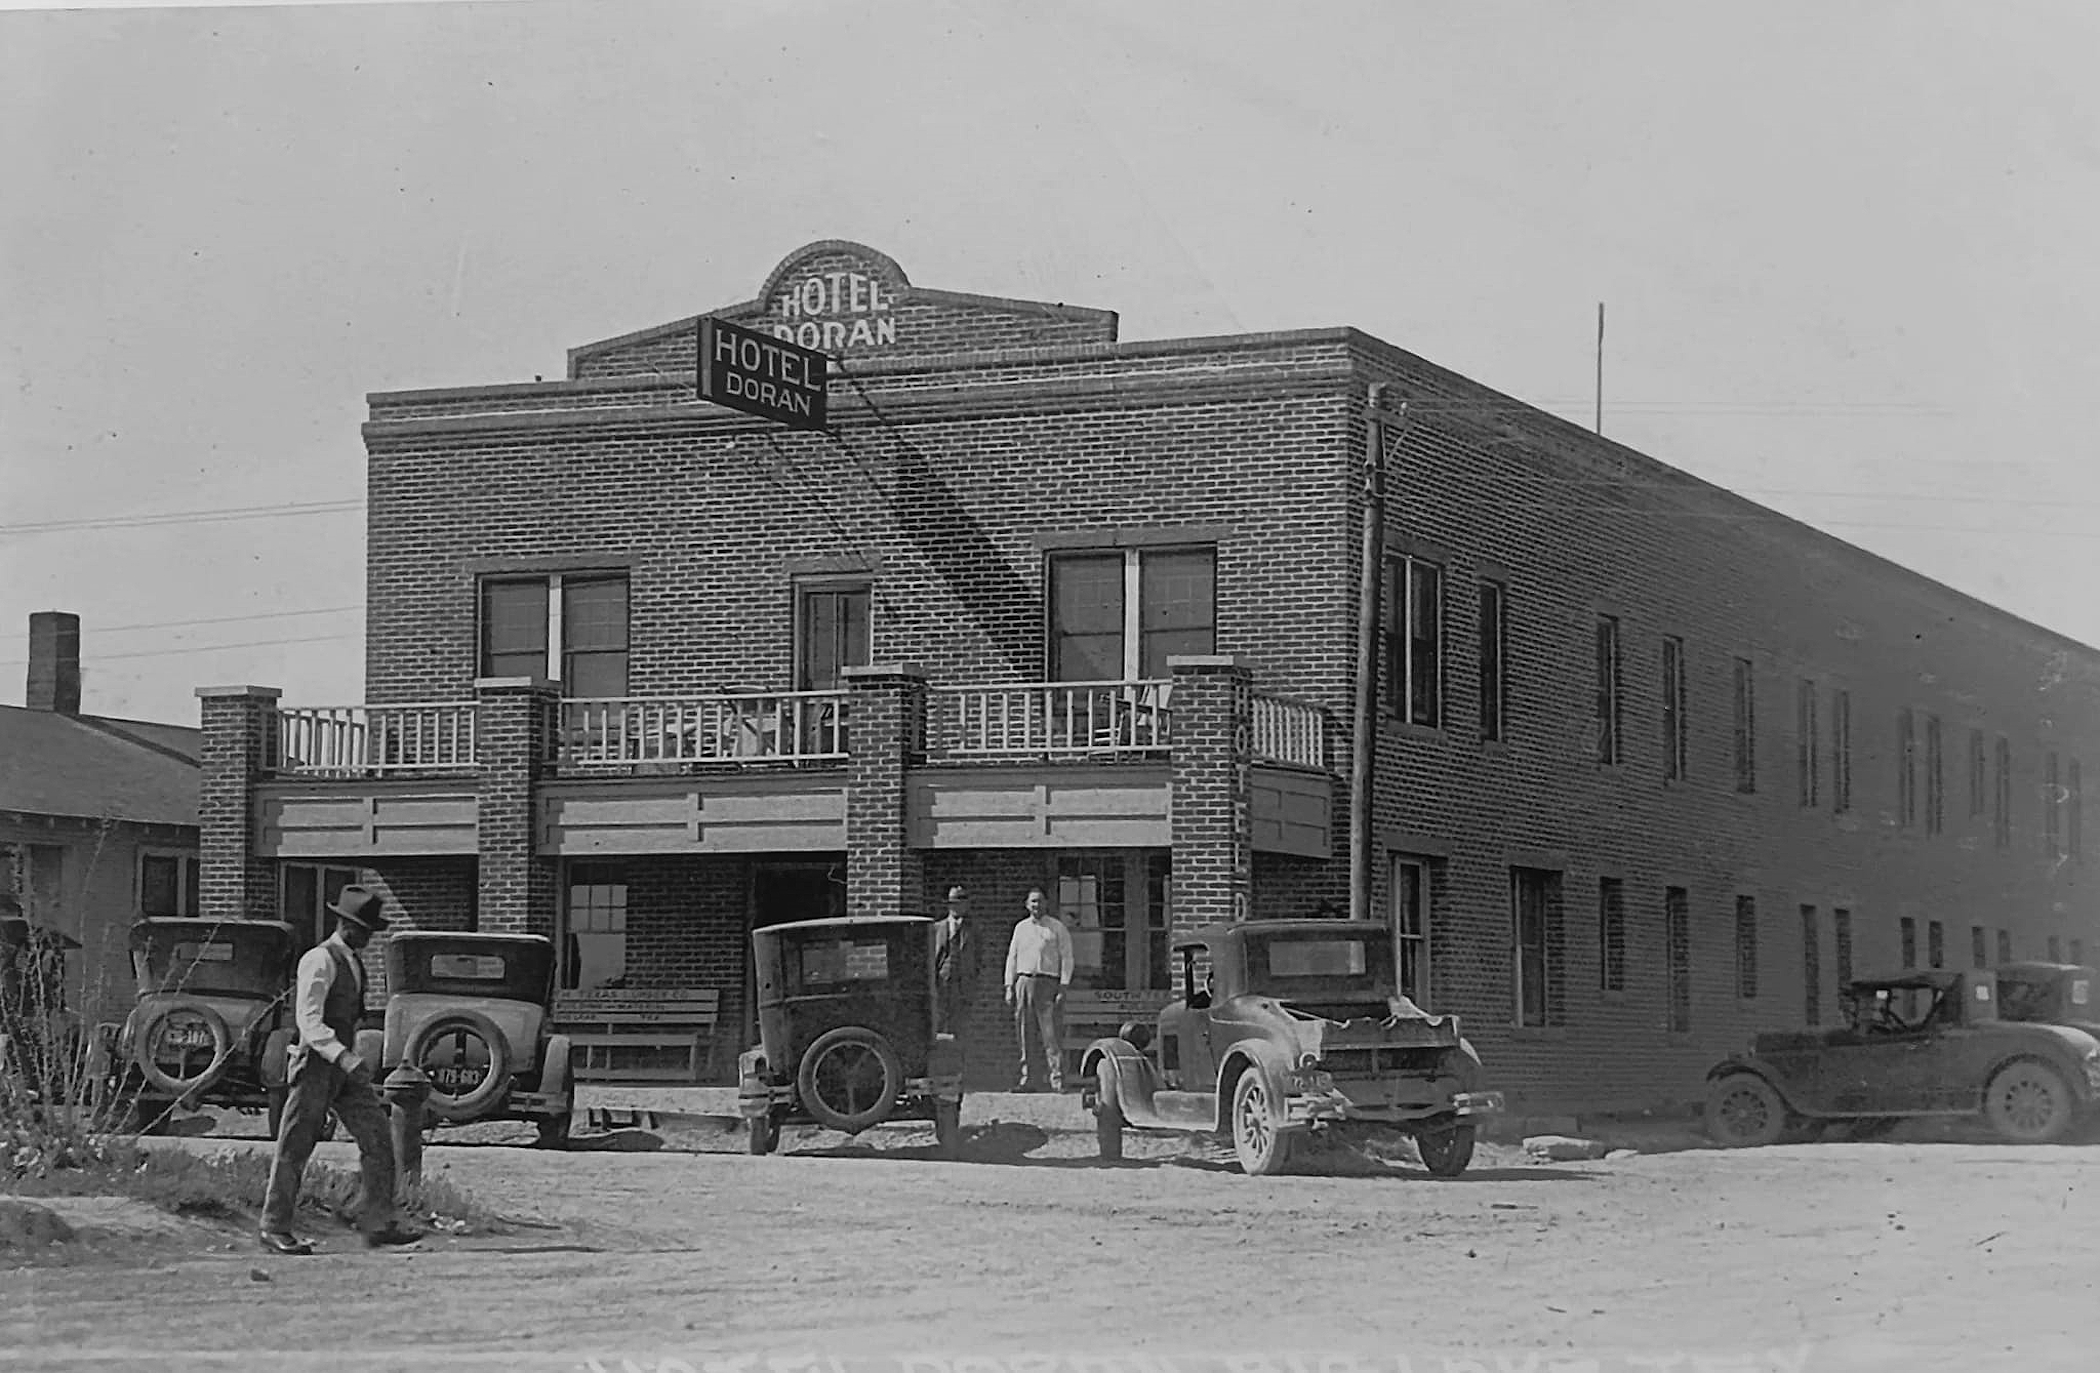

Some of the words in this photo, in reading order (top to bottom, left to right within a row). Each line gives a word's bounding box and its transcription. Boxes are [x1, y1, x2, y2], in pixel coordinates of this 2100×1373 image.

[782, 272, 889, 317] HOTEL
[773, 317, 896, 350] DORAN
[715, 328, 822, 392] HOTEL
[726, 371, 811, 417] DORAN
[1234, 685, 1248, 874] HOTEL
